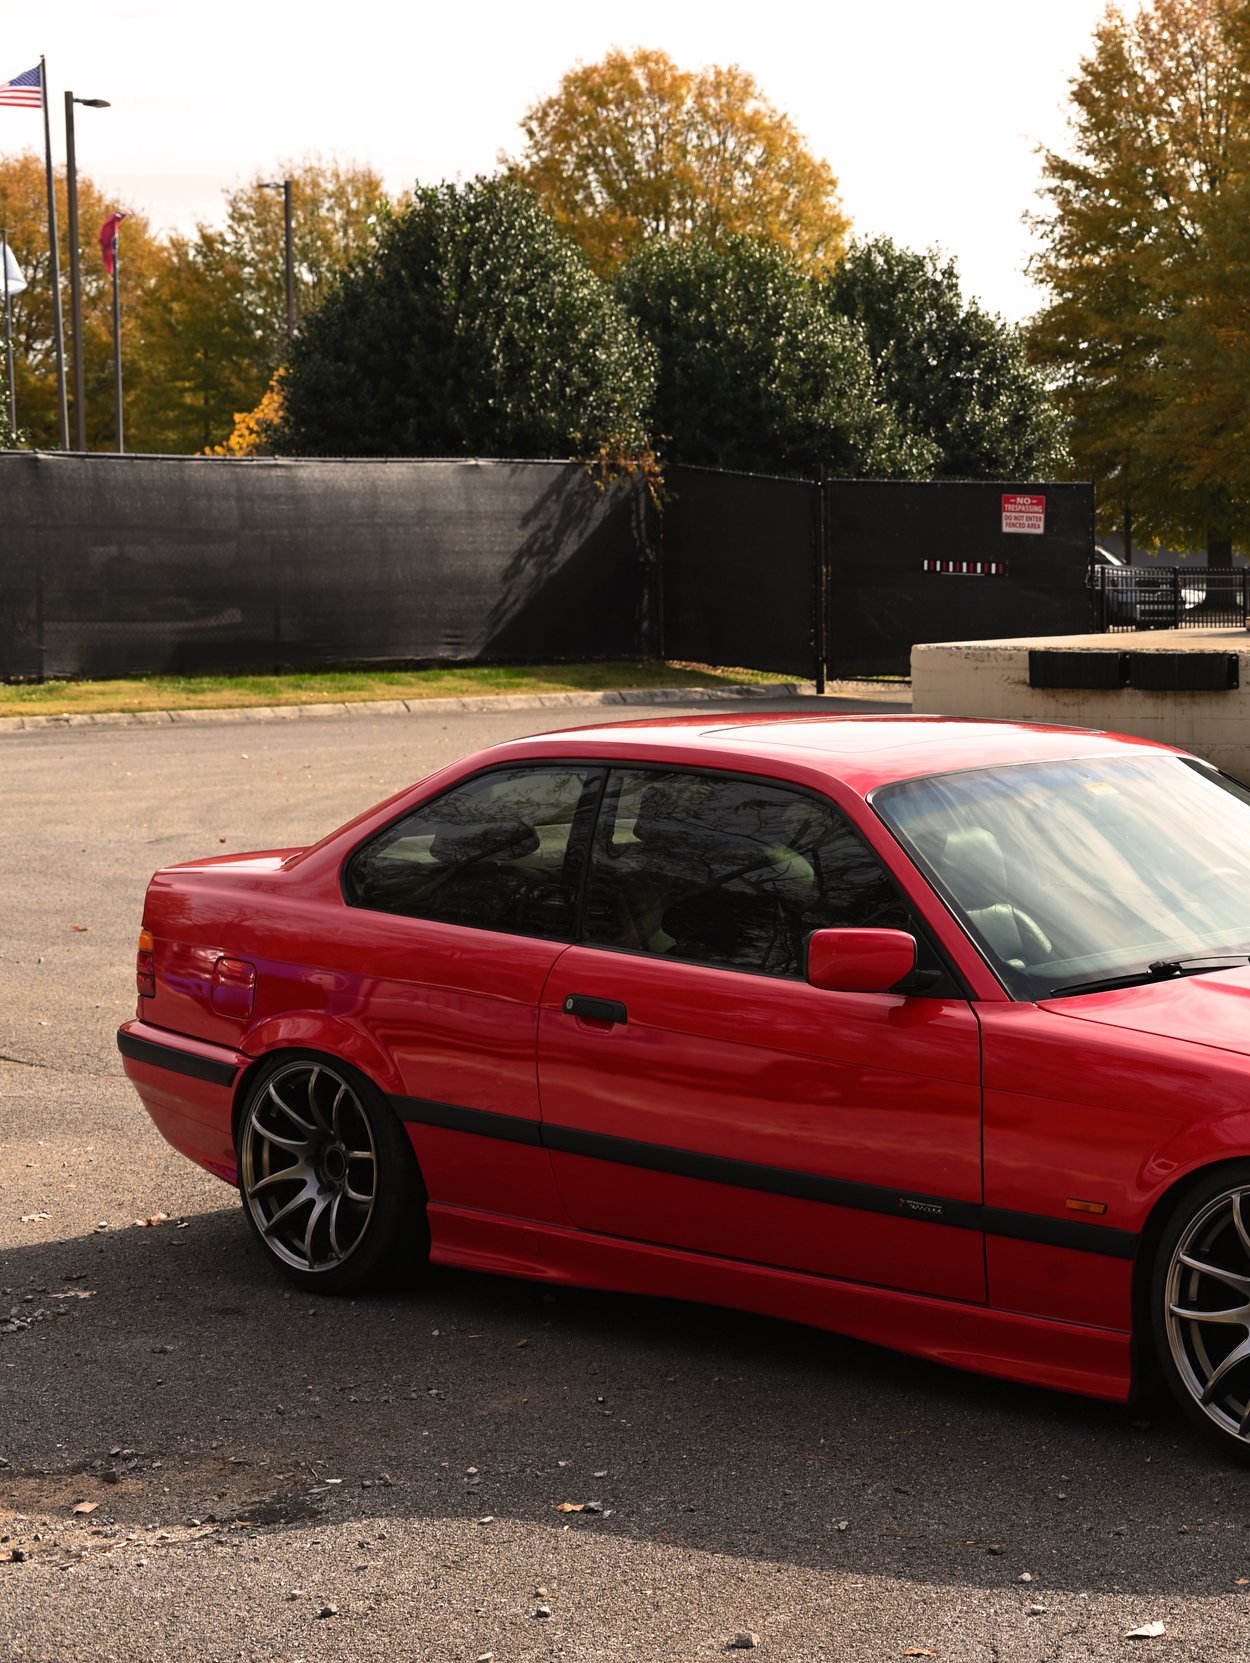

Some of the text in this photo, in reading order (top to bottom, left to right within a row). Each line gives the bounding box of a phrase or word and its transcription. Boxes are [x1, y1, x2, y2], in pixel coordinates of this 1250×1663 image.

[1016, 497, 1031, 505] NO
[1004, 504, 1043, 513] TRESPASSING
[1013, 514, 1025, 522] NOT
[1025, 515, 1042, 523] ENTER
[1027, 522, 1041, 530] AREA
